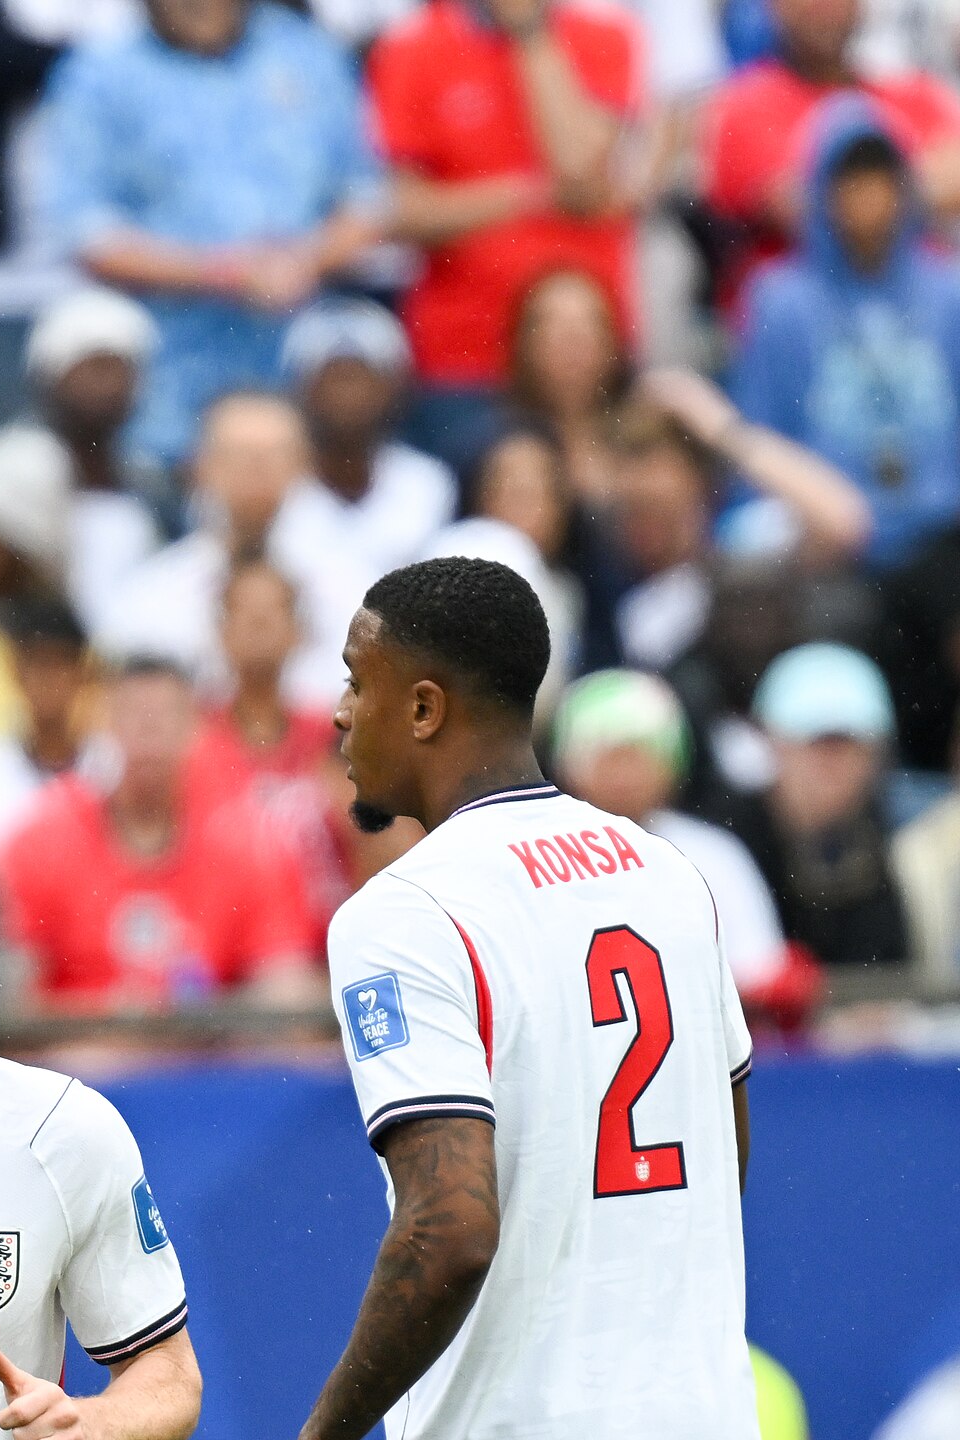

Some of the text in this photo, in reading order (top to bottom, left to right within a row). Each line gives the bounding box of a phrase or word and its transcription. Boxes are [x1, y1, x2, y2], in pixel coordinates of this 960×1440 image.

[508, 826, 644, 888] KONSA
[363, 1022, 390, 1041] PEACE
[585, 923, 688, 1199] 2
